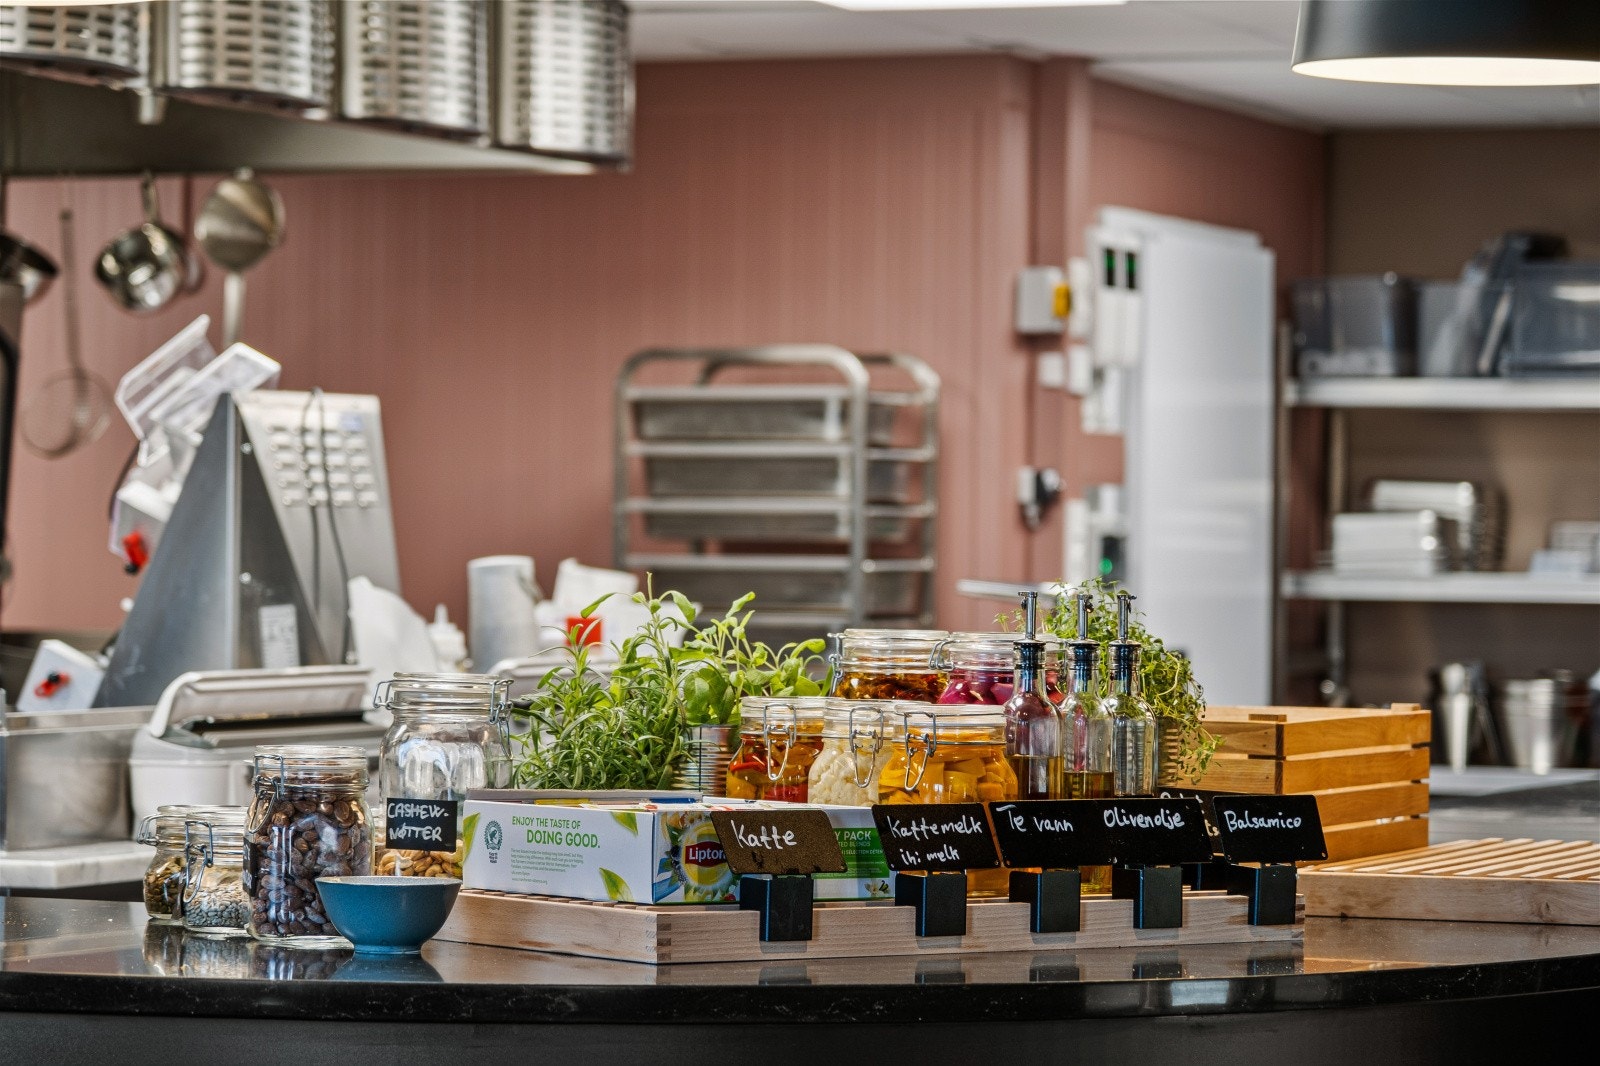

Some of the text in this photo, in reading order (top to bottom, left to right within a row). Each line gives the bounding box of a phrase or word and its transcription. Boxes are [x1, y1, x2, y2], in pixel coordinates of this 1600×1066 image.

[512, 816, 581, 829] ENJOY THE TASTE OF
[996, 804, 1074, 832] Te vann
[1103, 806, 1185, 830] Olivenolje
[1223, 809, 1302, 833] Balsamico
[389, 822, 442, 841] NØTTER
[526, 829, 600, 848] DOING GOOD.
[843, 831, 872, 841] PACK
[926, 843, 960, 862] melk
